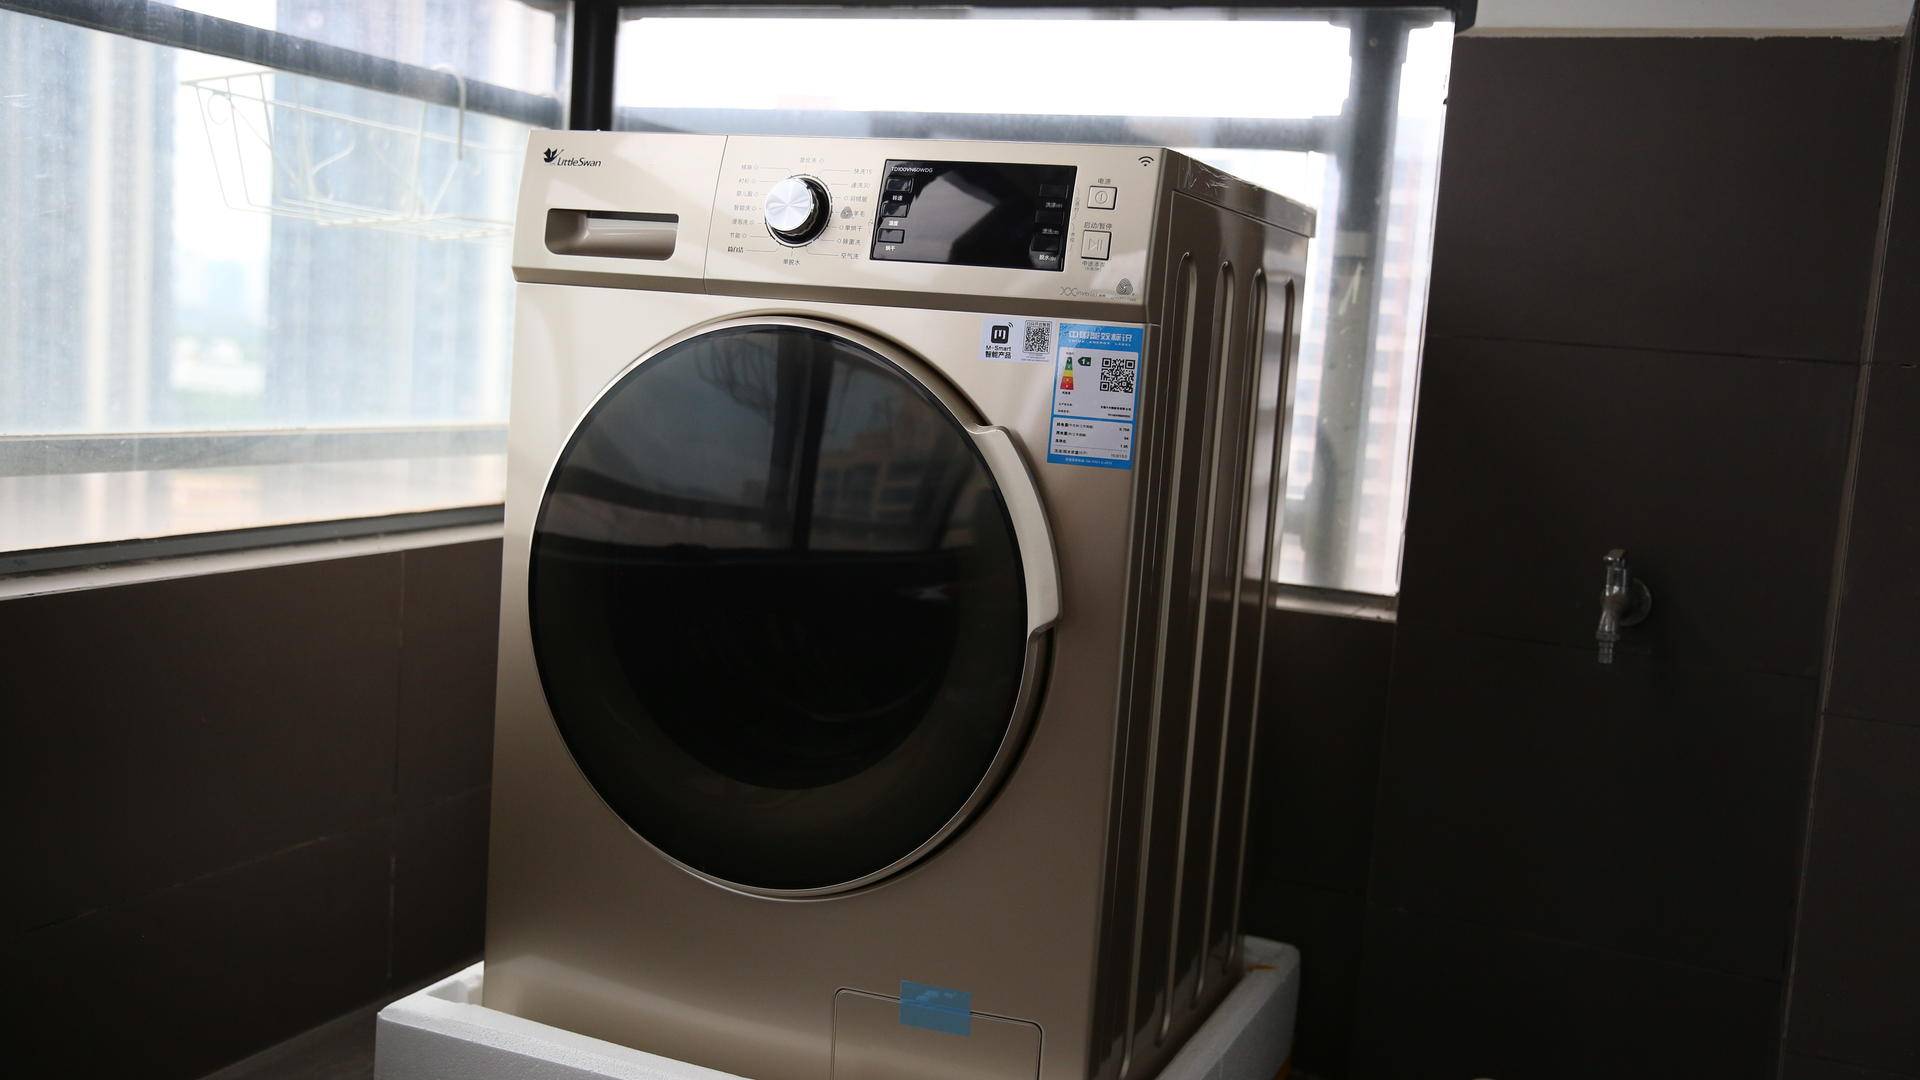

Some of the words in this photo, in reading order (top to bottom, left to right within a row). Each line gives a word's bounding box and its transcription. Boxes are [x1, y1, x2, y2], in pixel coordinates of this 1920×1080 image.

[557, 157, 602, 167] LittleSwan
[1083, 222, 1113, 231] 启动/暂停
[985, 351, 1012, 359] 智能产品
